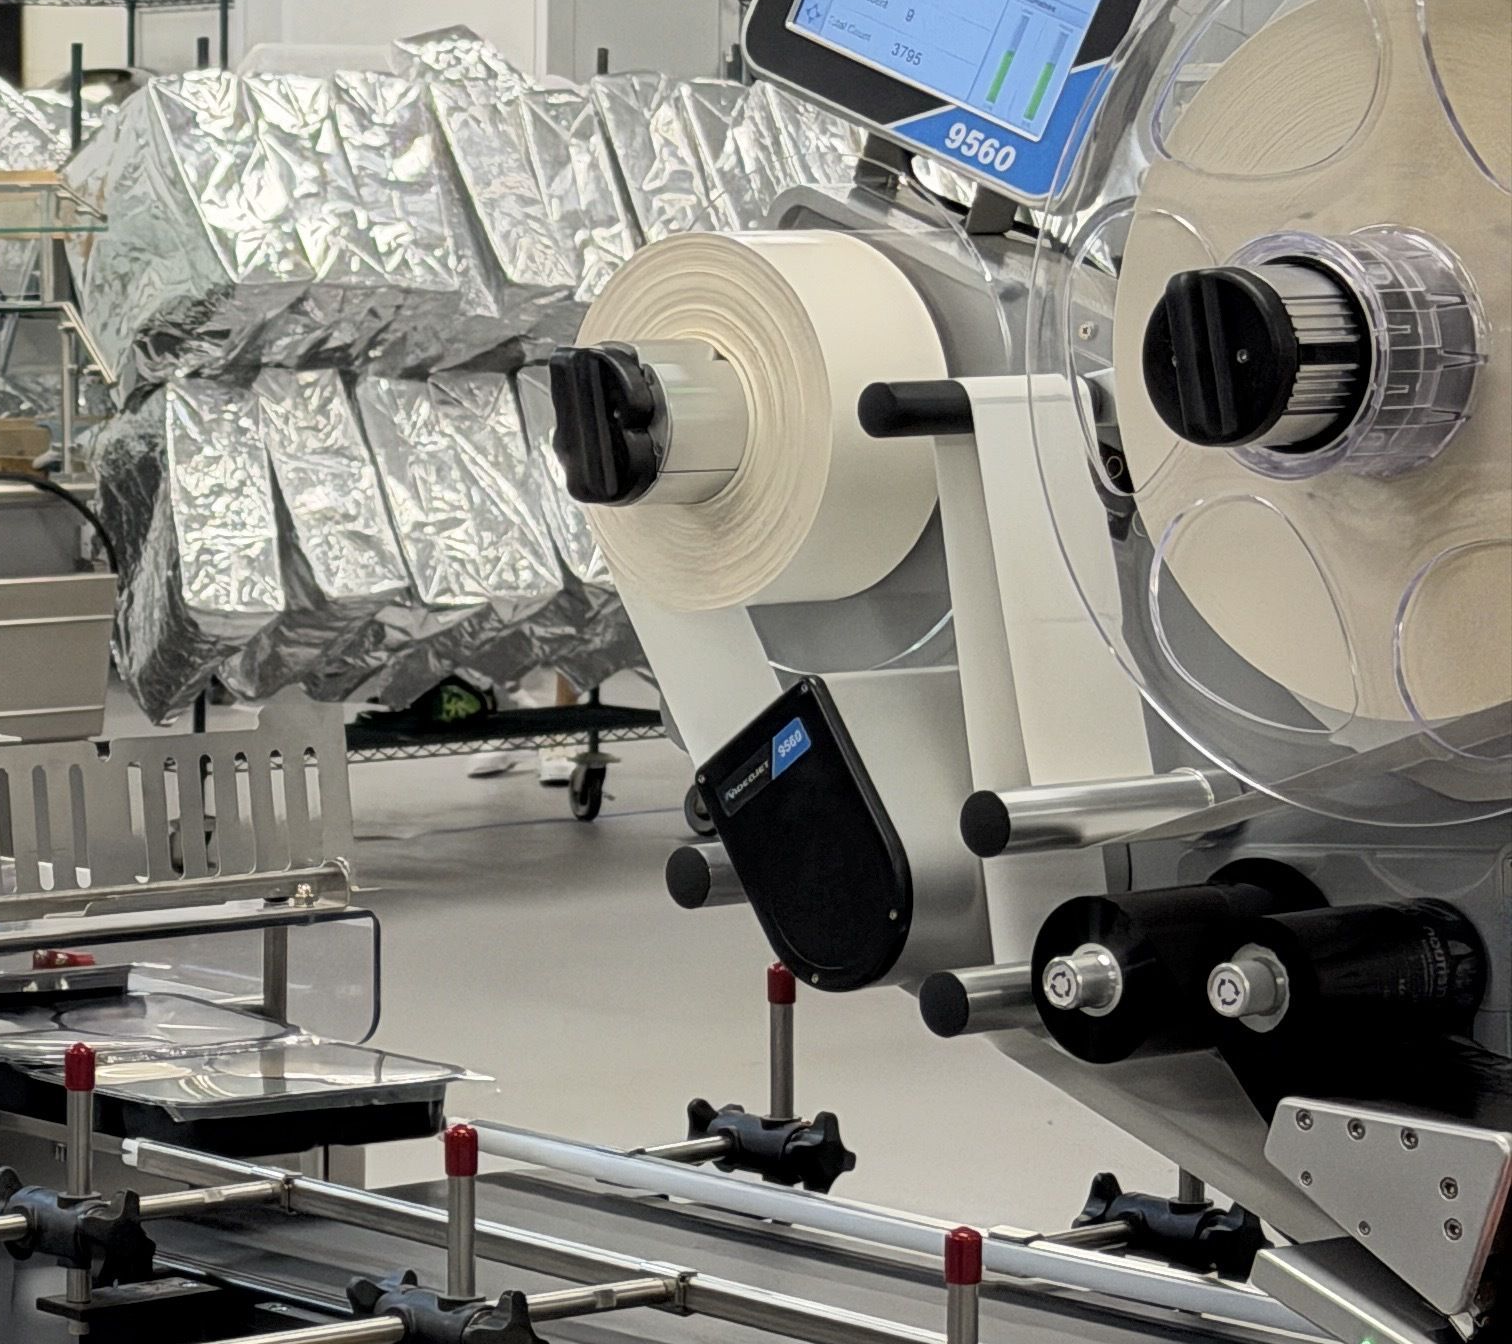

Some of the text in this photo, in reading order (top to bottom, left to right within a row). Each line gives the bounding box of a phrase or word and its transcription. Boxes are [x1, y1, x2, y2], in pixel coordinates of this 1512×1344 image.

[890, 42, 924, 67] 3795
[944, 122, 1017, 172] 9560
[725, 729, 803, 800] VIDEOJET 9560
